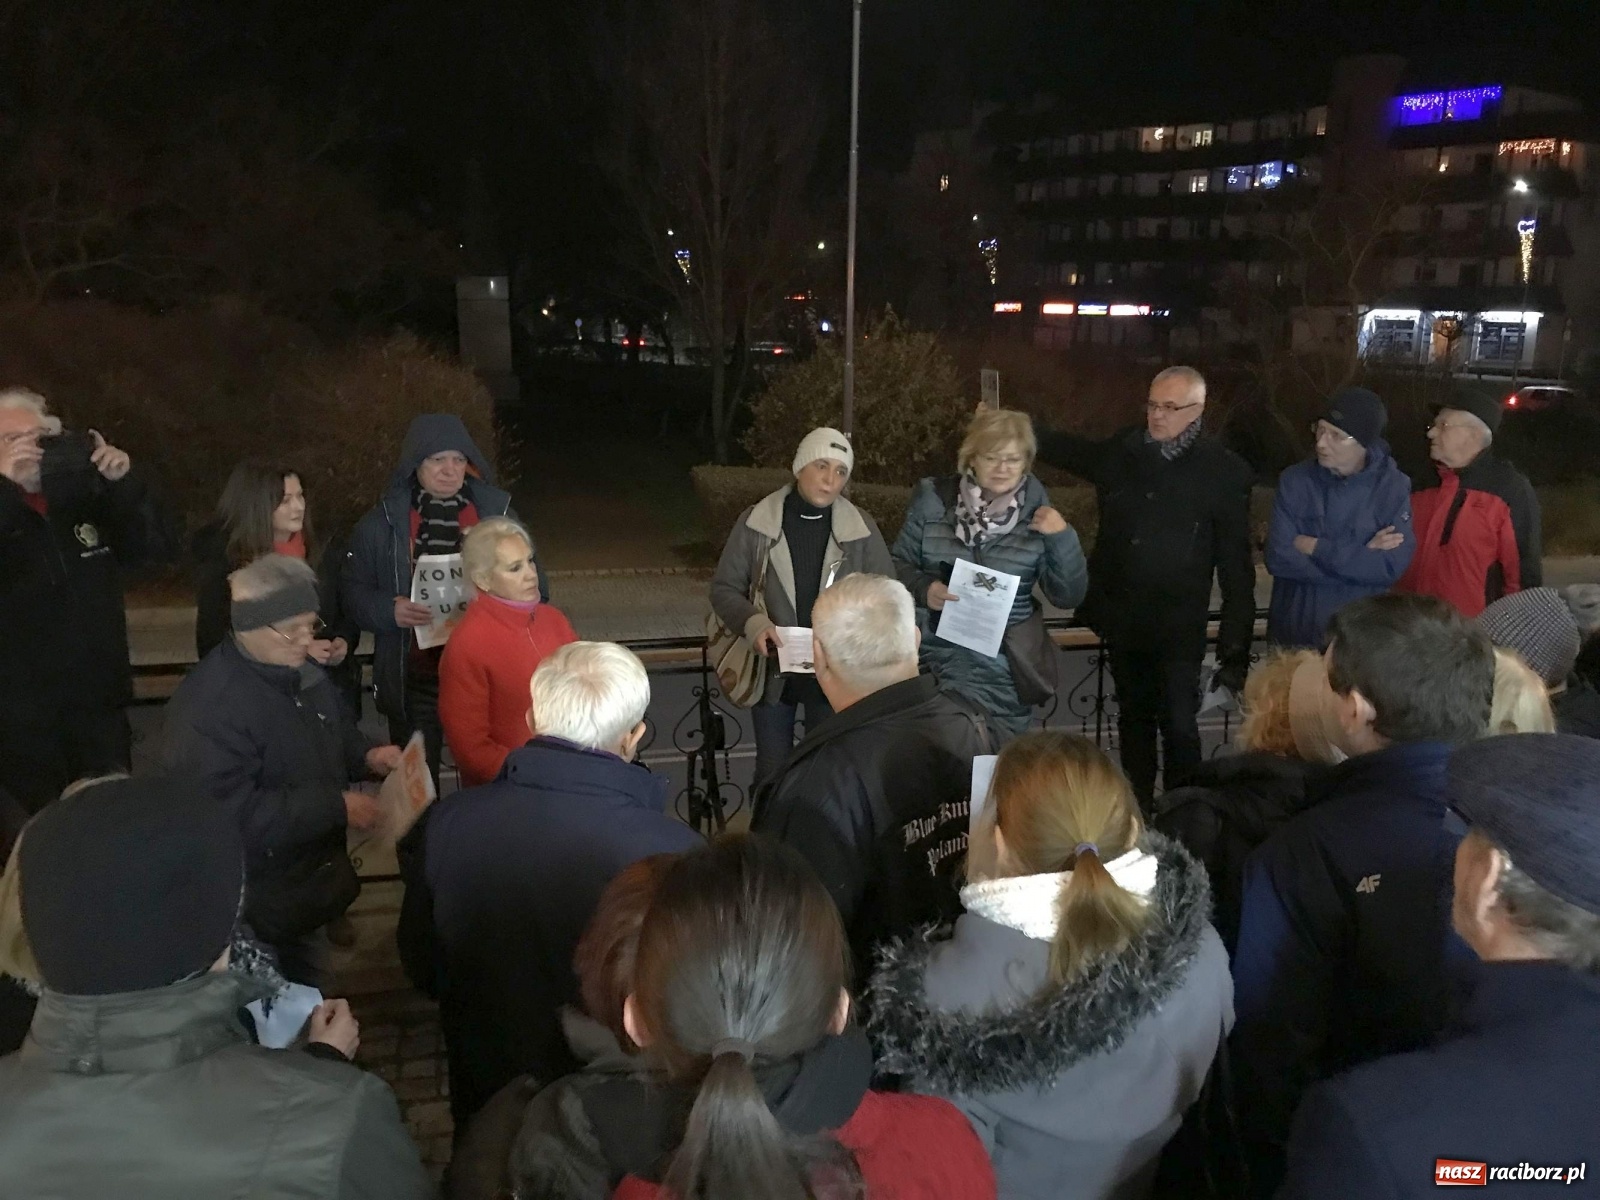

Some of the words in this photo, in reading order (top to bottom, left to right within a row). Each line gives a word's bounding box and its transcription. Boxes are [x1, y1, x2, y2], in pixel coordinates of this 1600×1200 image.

[419, 567, 463, 582] KON
[420, 585, 463, 600] STY
[901, 815, 937, 852] Blue
[938, 796, 970, 826] Kni
[1356, 873, 1382, 894] 4F
